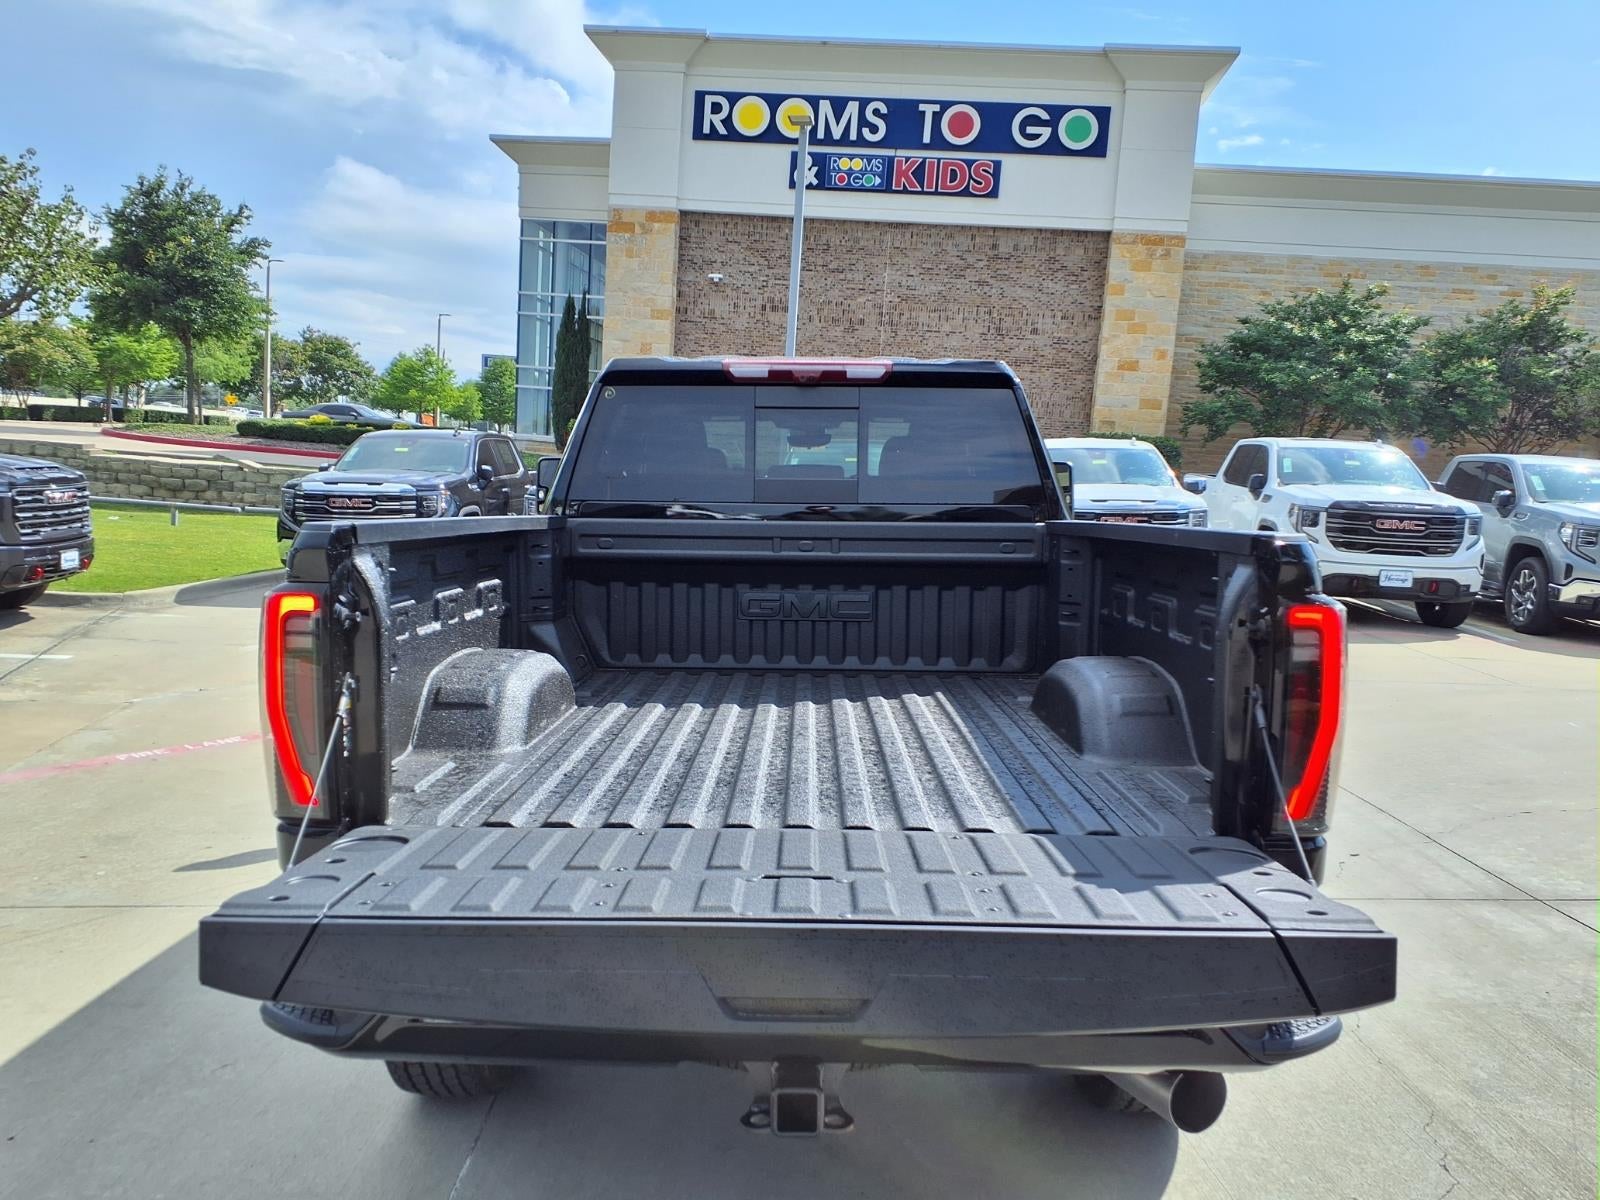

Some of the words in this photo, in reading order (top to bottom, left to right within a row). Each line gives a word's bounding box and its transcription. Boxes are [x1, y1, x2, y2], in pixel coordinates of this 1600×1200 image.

[702, 94, 887, 143] ROOMS
[918, 103, 981, 146] TO
[1011, 106, 1099, 150] GO
[830, 156, 883, 172] ROOMS
[830, 172, 848, 185] TO
[850, 173, 875, 186] GO
[892, 156, 995, 195] KIDS
[328, 497, 373, 508] GMC
[1375, 518, 1426, 531] GMC
[740, 590, 870, 620] GMC
